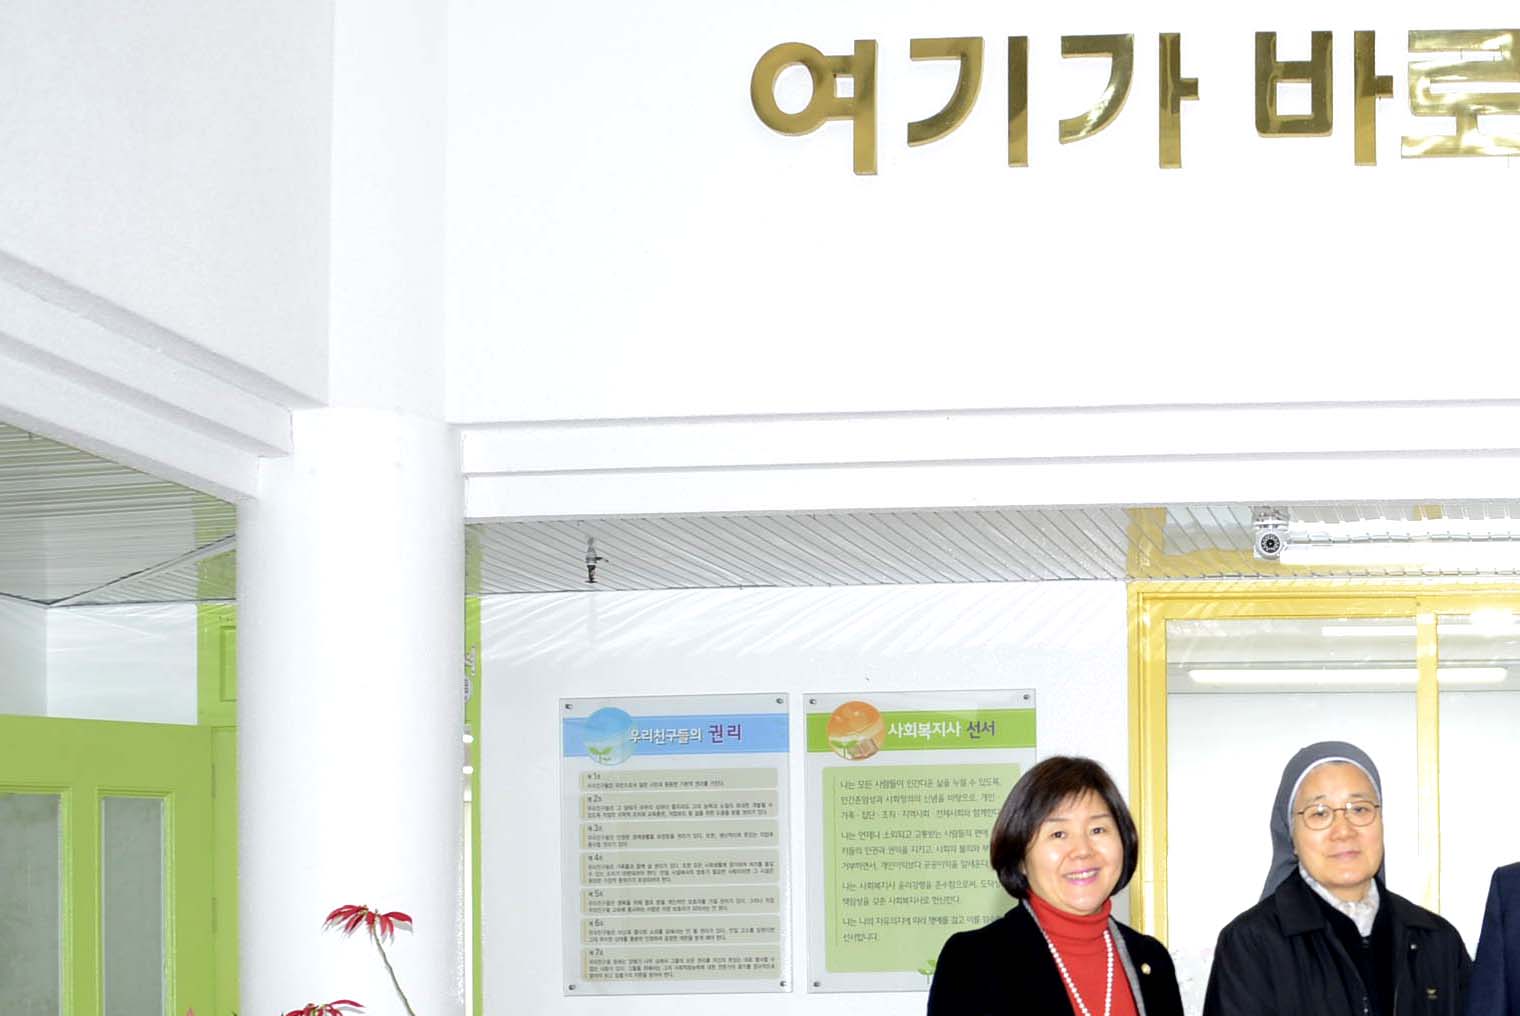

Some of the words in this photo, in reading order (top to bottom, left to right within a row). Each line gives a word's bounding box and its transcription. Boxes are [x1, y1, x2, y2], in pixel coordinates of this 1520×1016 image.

[749, 33, 1199, 175] 여기가
[628, 727, 703, 745] 우리친구들의
[708, 723, 743, 743] 권리
[887, 720, 962, 740] 사회복지사
[966, 720, 996, 740] 선서
